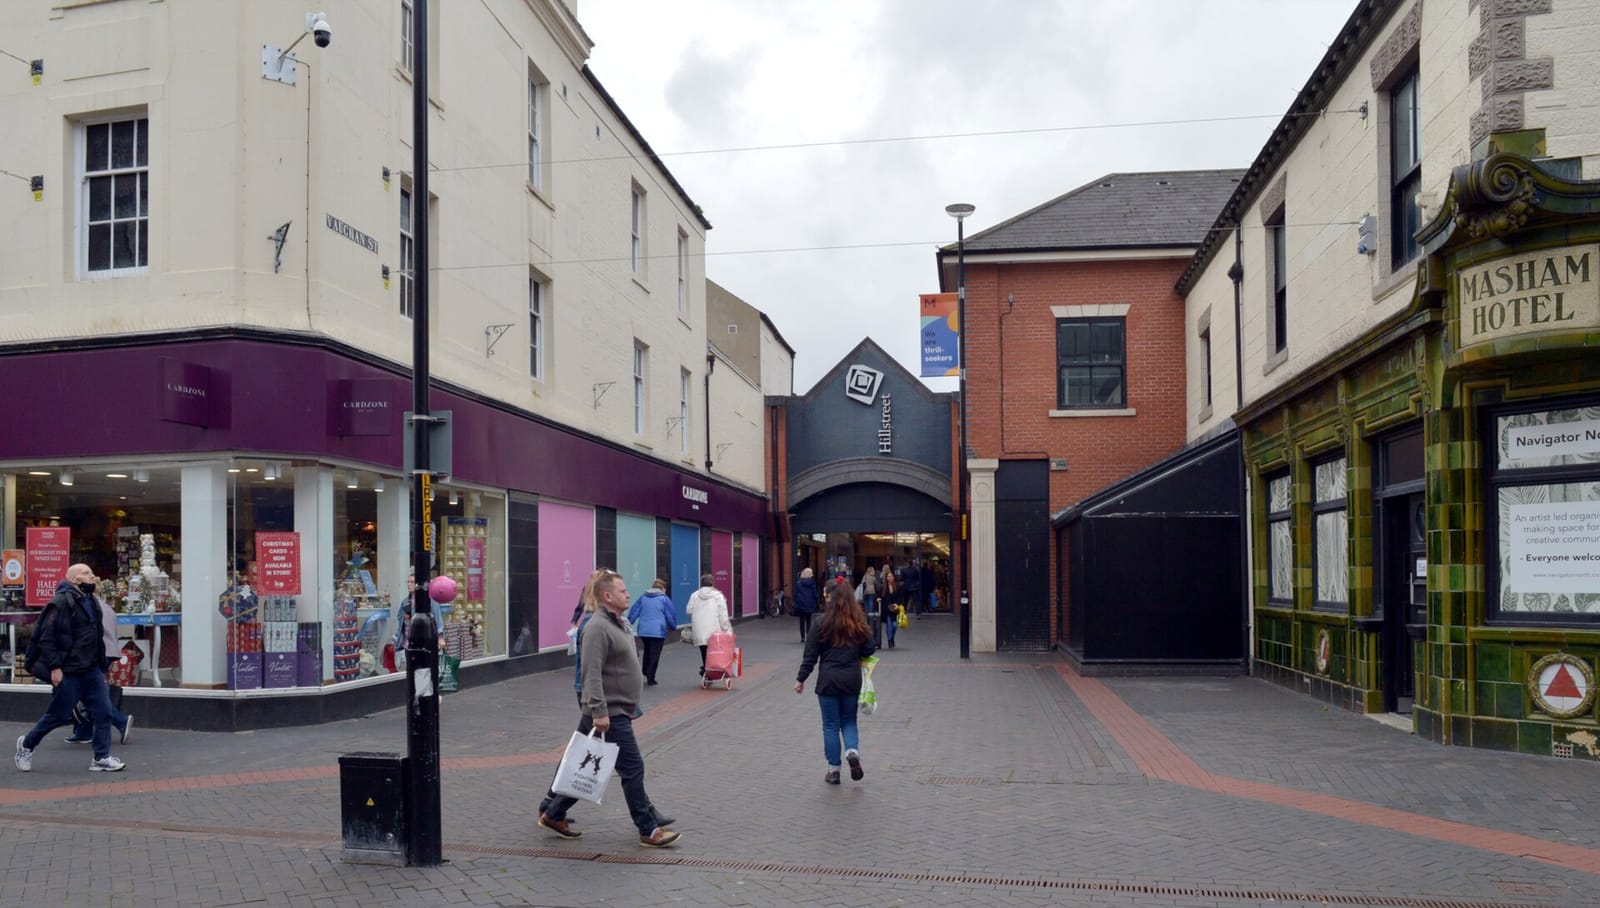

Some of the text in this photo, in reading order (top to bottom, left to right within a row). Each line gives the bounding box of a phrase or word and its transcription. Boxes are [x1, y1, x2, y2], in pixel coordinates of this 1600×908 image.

[327, 215, 378, 253] VAUGHAN ST
[1463, 252, 1591, 305] MASHAM
[924, 298, 936, 308] M
[1472, 292, 1576, 336] HOTEL
[925, 354, 953, 362] seekers
[167, 383, 206, 397] CARDZONE
[878, 393, 891, 453] Hillstreet
[1516, 434, 1581, 447] Navigator
[682, 485, 708, 504] CARDZONE
[1529, 513, 1551, 521] artist
[1553, 512, 1568, 520] led
[1523, 522, 1600, 534] making space for
[1526, 536, 1560, 544] creative
[1526, 553, 1570, 563] Everyone
[1573, 553, 1600, 561] welco
[37, 580, 57, 588] HALF
